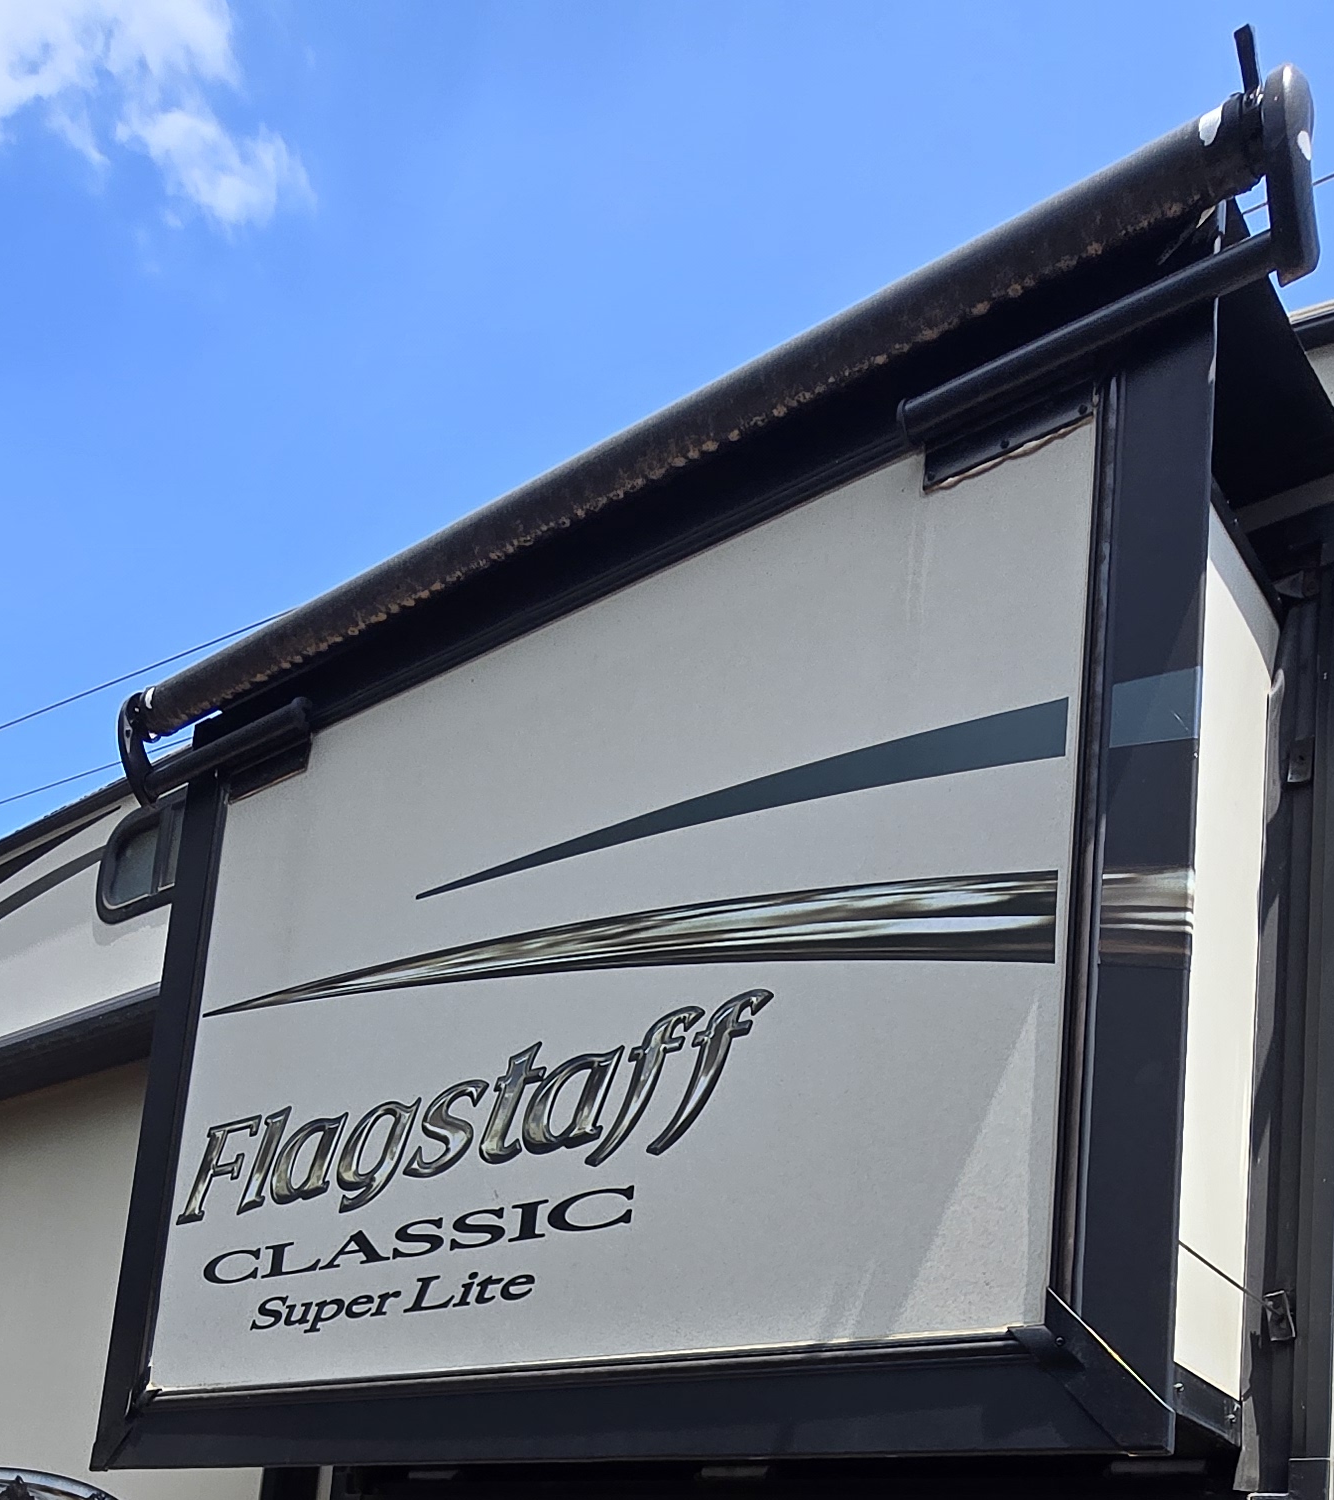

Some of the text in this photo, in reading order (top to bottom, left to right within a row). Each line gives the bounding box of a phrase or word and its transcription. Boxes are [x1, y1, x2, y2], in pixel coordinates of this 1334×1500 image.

[175, 988, 774, 1225] Flagstaff
[202, 1185, 635, 1285] CLASSIC
[249, 1271, 536, 1333] Super Lite
